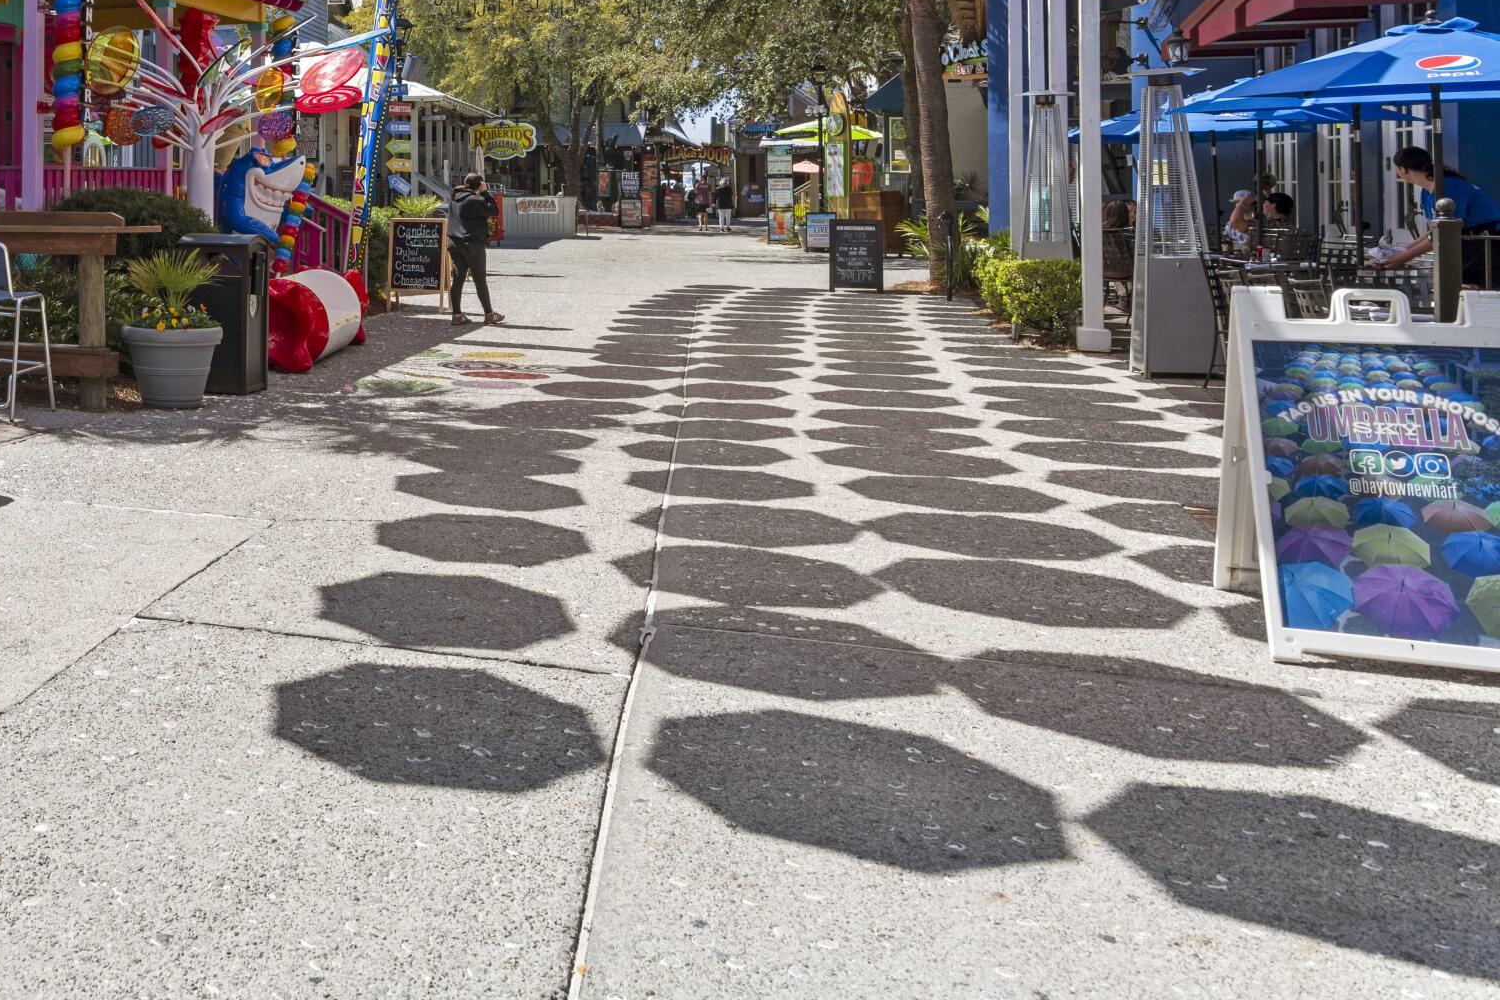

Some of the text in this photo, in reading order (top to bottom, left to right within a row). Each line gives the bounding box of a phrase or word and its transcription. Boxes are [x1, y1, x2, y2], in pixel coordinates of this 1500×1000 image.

[1426, 71, 1481, 79] pepsi
[473, 127, 533, 148] ROBERTO'S
[621, 171, 639, 180] FREE
[528, 200, 557, 208] PIZZA
[396, 224, 439, 237] Candied
[395, 247, 419, 256] Dubai
[1277, 403, 1313, 423] TAG
[1312, 393, 1339, 409] US
[1339, 388, 1364, 403] IN
[1364, 387, 1420, 405] YOUR
[1306, 404, 1472, 450] UMBRELLA
[1352, 421, 1422, 436] SKY
[1349, 477, 1458, 500] @baytownewharf
